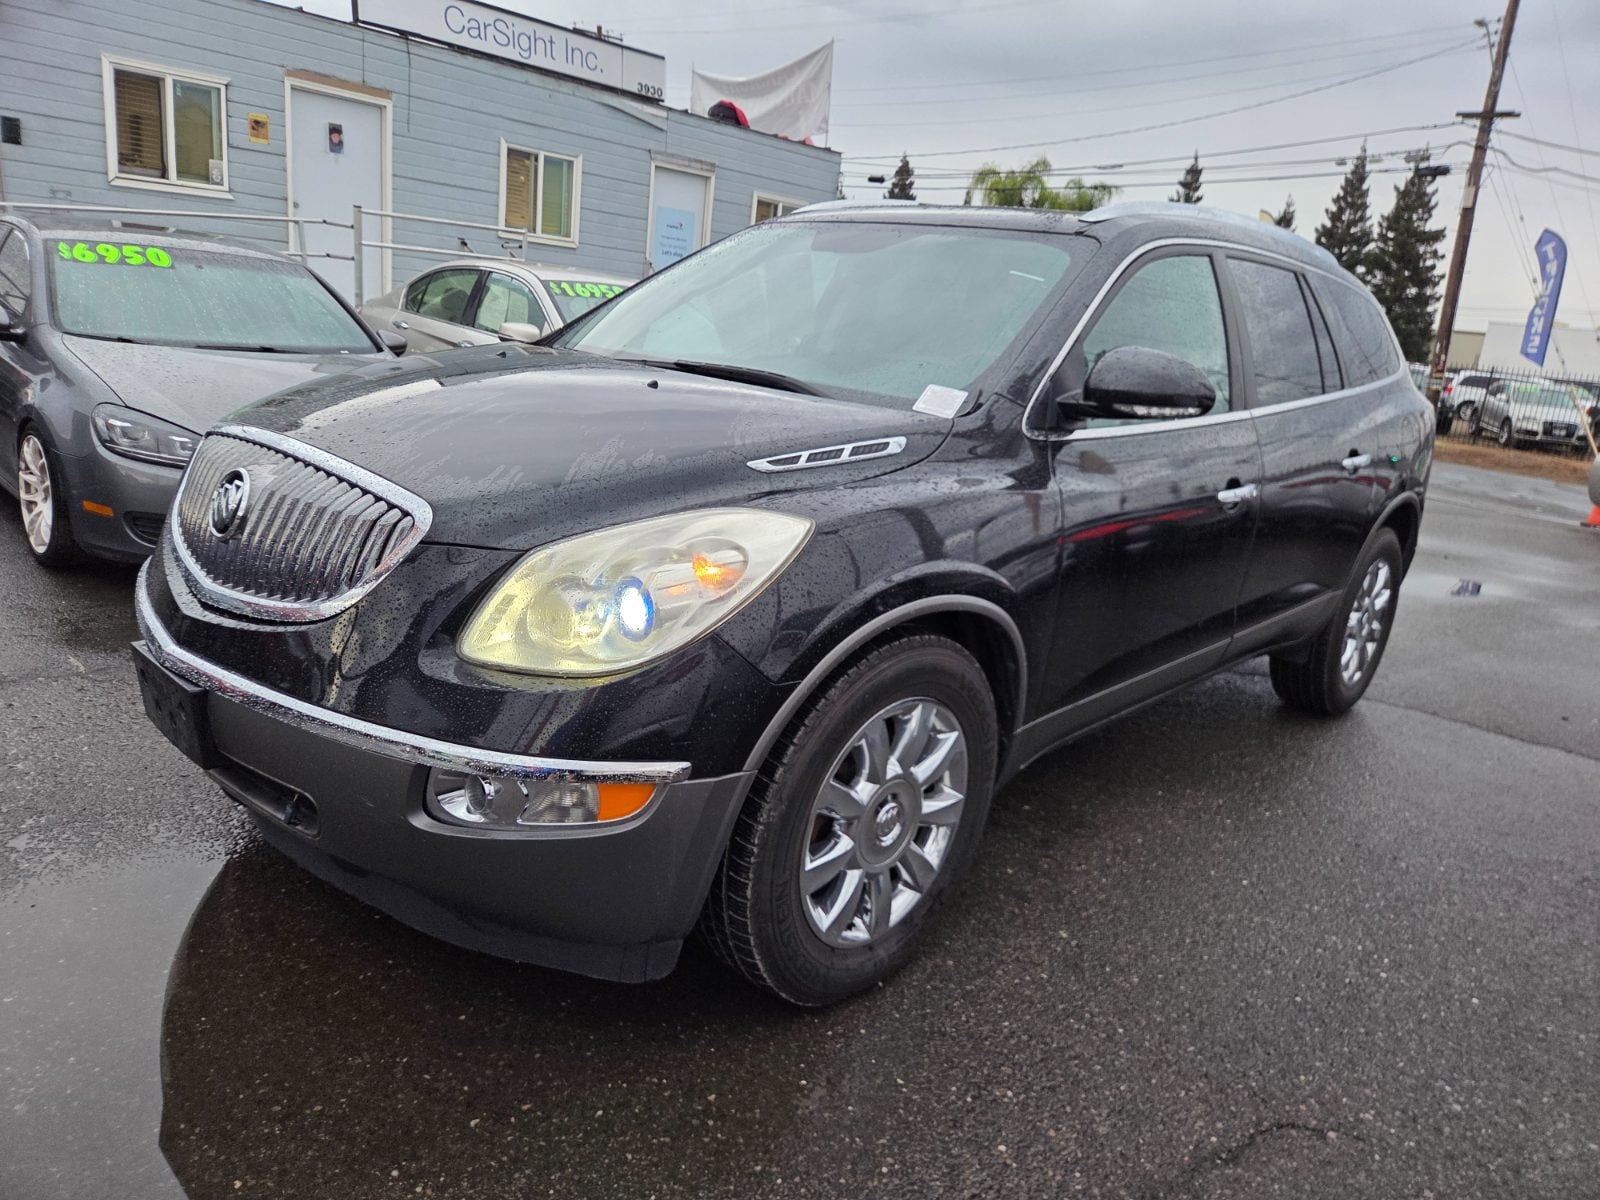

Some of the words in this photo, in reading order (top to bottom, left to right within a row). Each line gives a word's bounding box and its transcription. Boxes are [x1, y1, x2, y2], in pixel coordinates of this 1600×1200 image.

[444, 5, 556, 60] CarSight
[565, 38, 604, 73] Inc.
[636, 82, 663, 98] 3930
[57, 241, 172, 268] $6950
